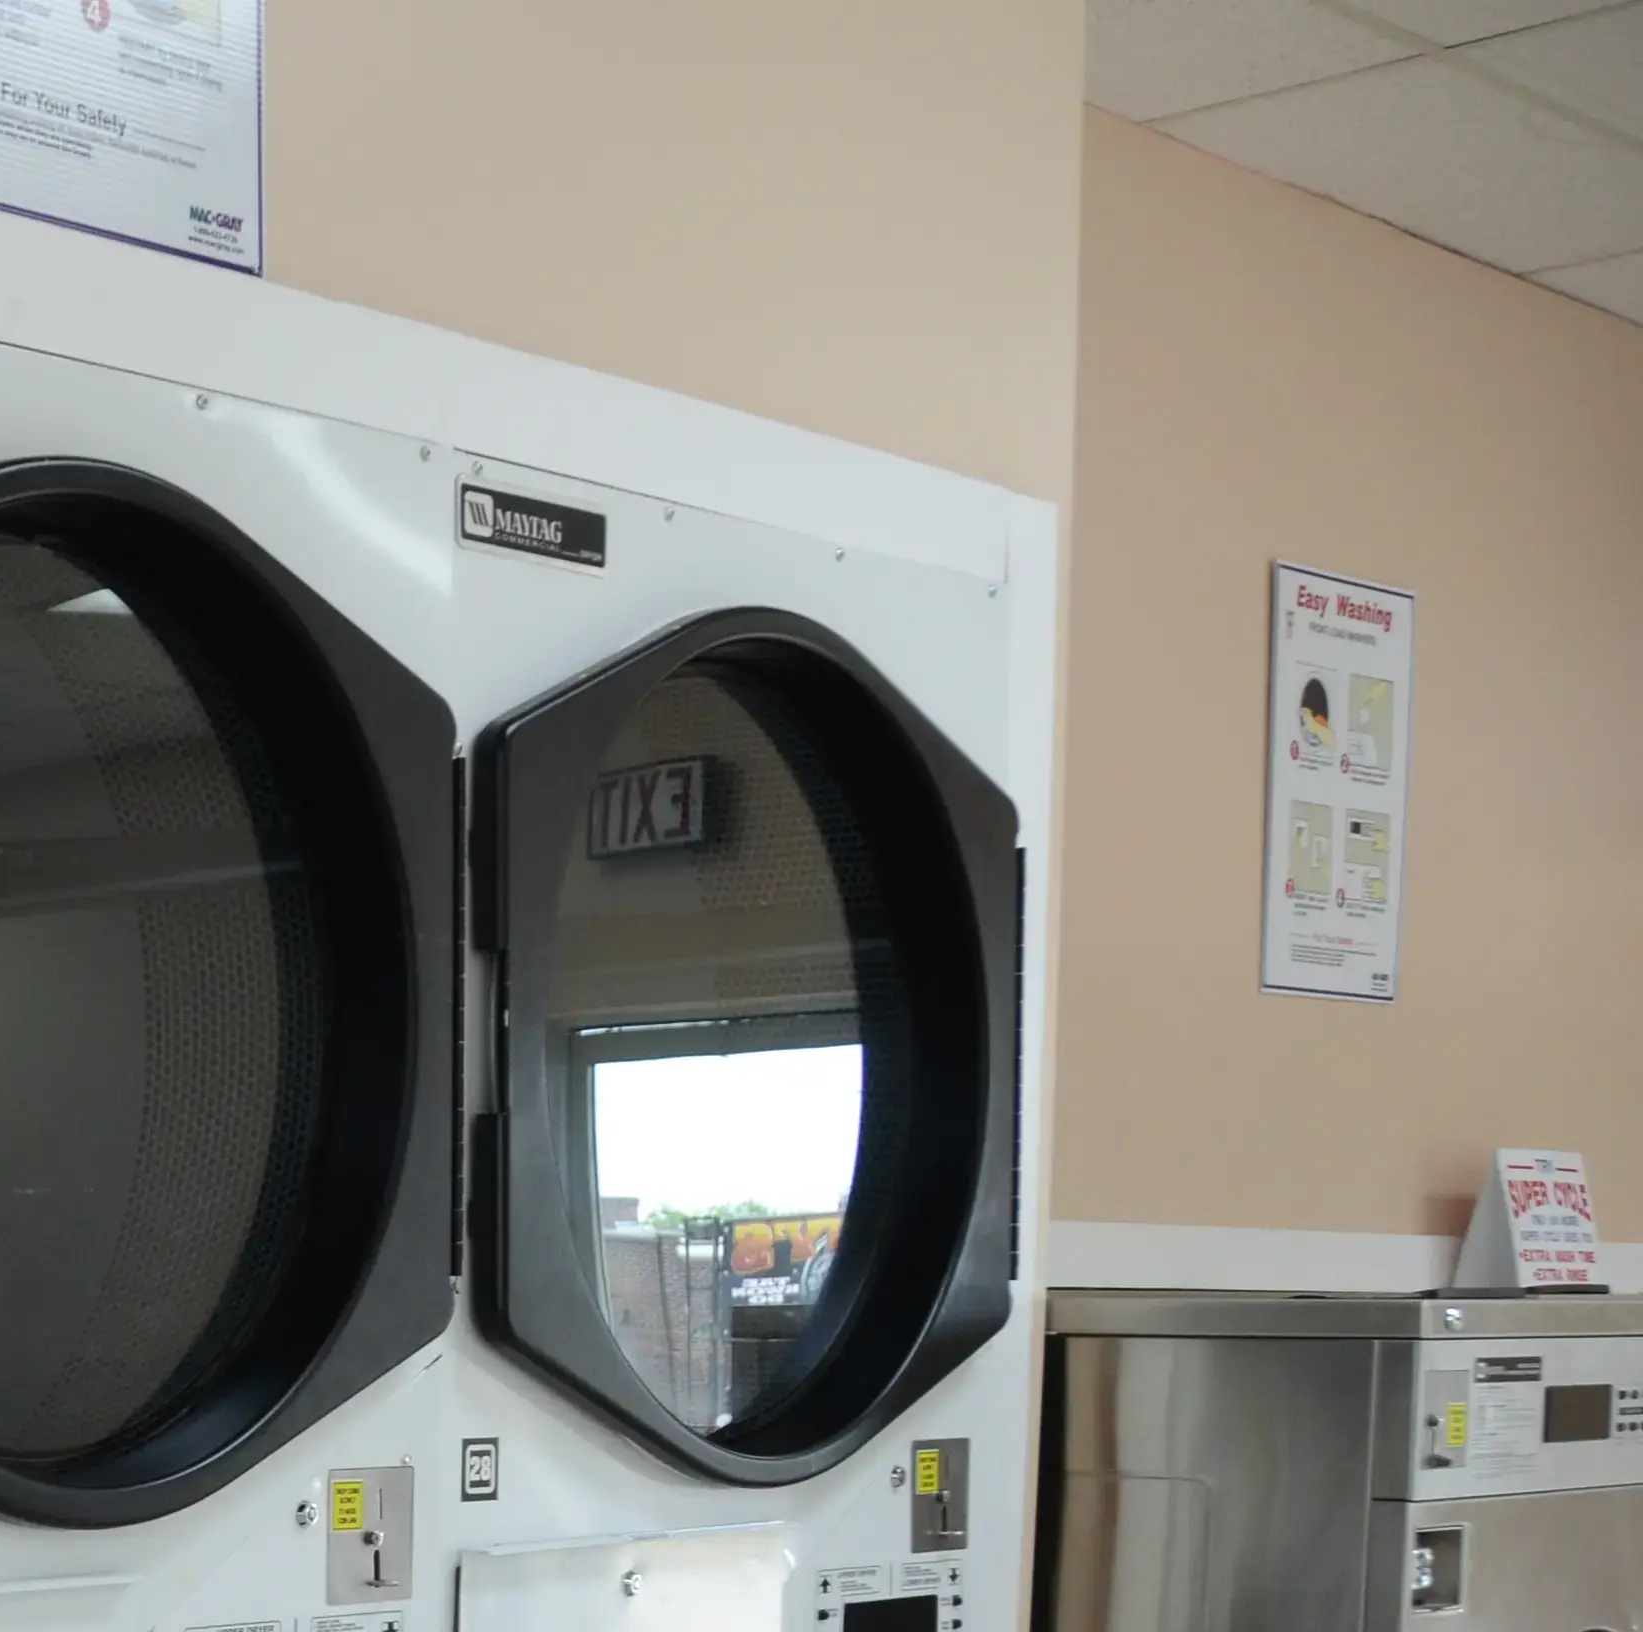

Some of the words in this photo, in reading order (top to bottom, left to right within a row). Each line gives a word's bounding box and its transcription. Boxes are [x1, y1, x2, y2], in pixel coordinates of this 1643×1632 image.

[0, 81, 27, 108] For
[34, 90, 70, 119] Your
[494, 532, 560, 552] COMMERCIAL
[495, 508, 563, 543] MAYTAG
[1297, 584, 1329, 618] Easy
[1336, 593, 1392, 633] Washing
[1508, 1180, 1551, 1218] SUPER
[1553, 1181, 1591, 1221] CYCLE
[470, 1455, 491, 1481] 28
